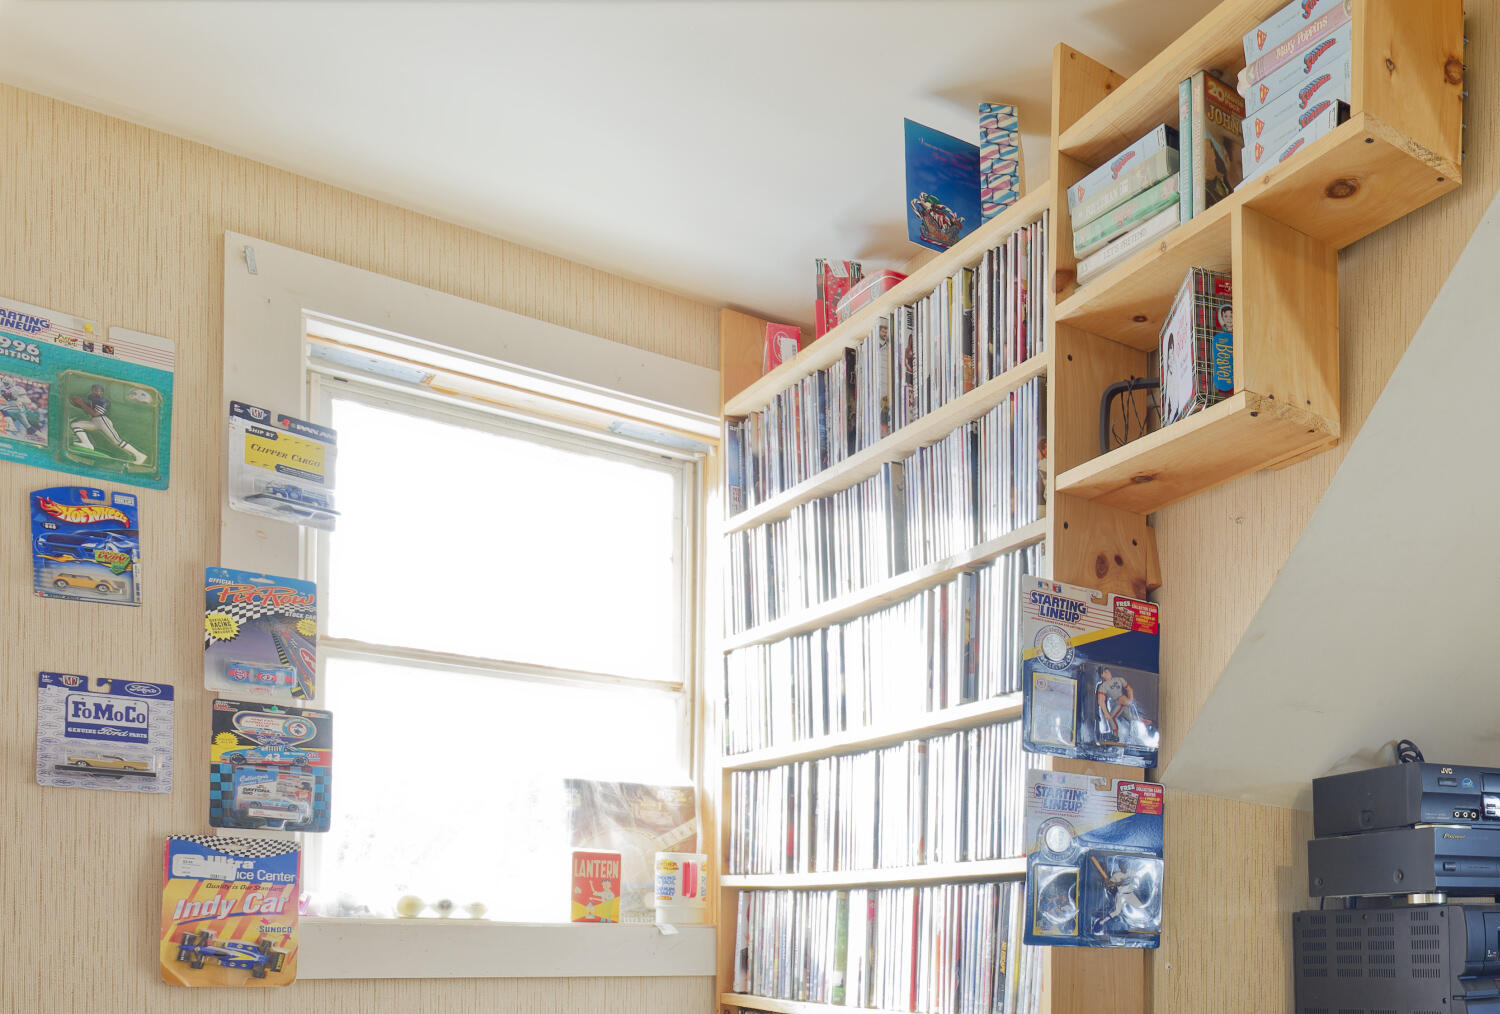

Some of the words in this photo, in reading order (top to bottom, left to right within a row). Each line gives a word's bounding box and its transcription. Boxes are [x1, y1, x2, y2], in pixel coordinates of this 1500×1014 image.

[1207, 104, 1240, 136] JOHN
[0, 308, 50, 329] ARTING
[0, 318, 41, 333] INEUP
[0, 336, 39, 357] 996
[250, 443, 288, 459] CLIPPER
[1031, 591, 1087, 615] STARTING
[1039, 605, 1080, 623] LINEUP
[71, 700, 146, 724] FoMoCo
[98, 726, 129, 737] Ford
[1042, 798, 1083, 813] LINEUP
[256, 869, 296, 882] Center
[573, 858, 619, 879] LANTERN
[173, 894, 237, 920] Indy
[242, 892, 289, 913] Car
